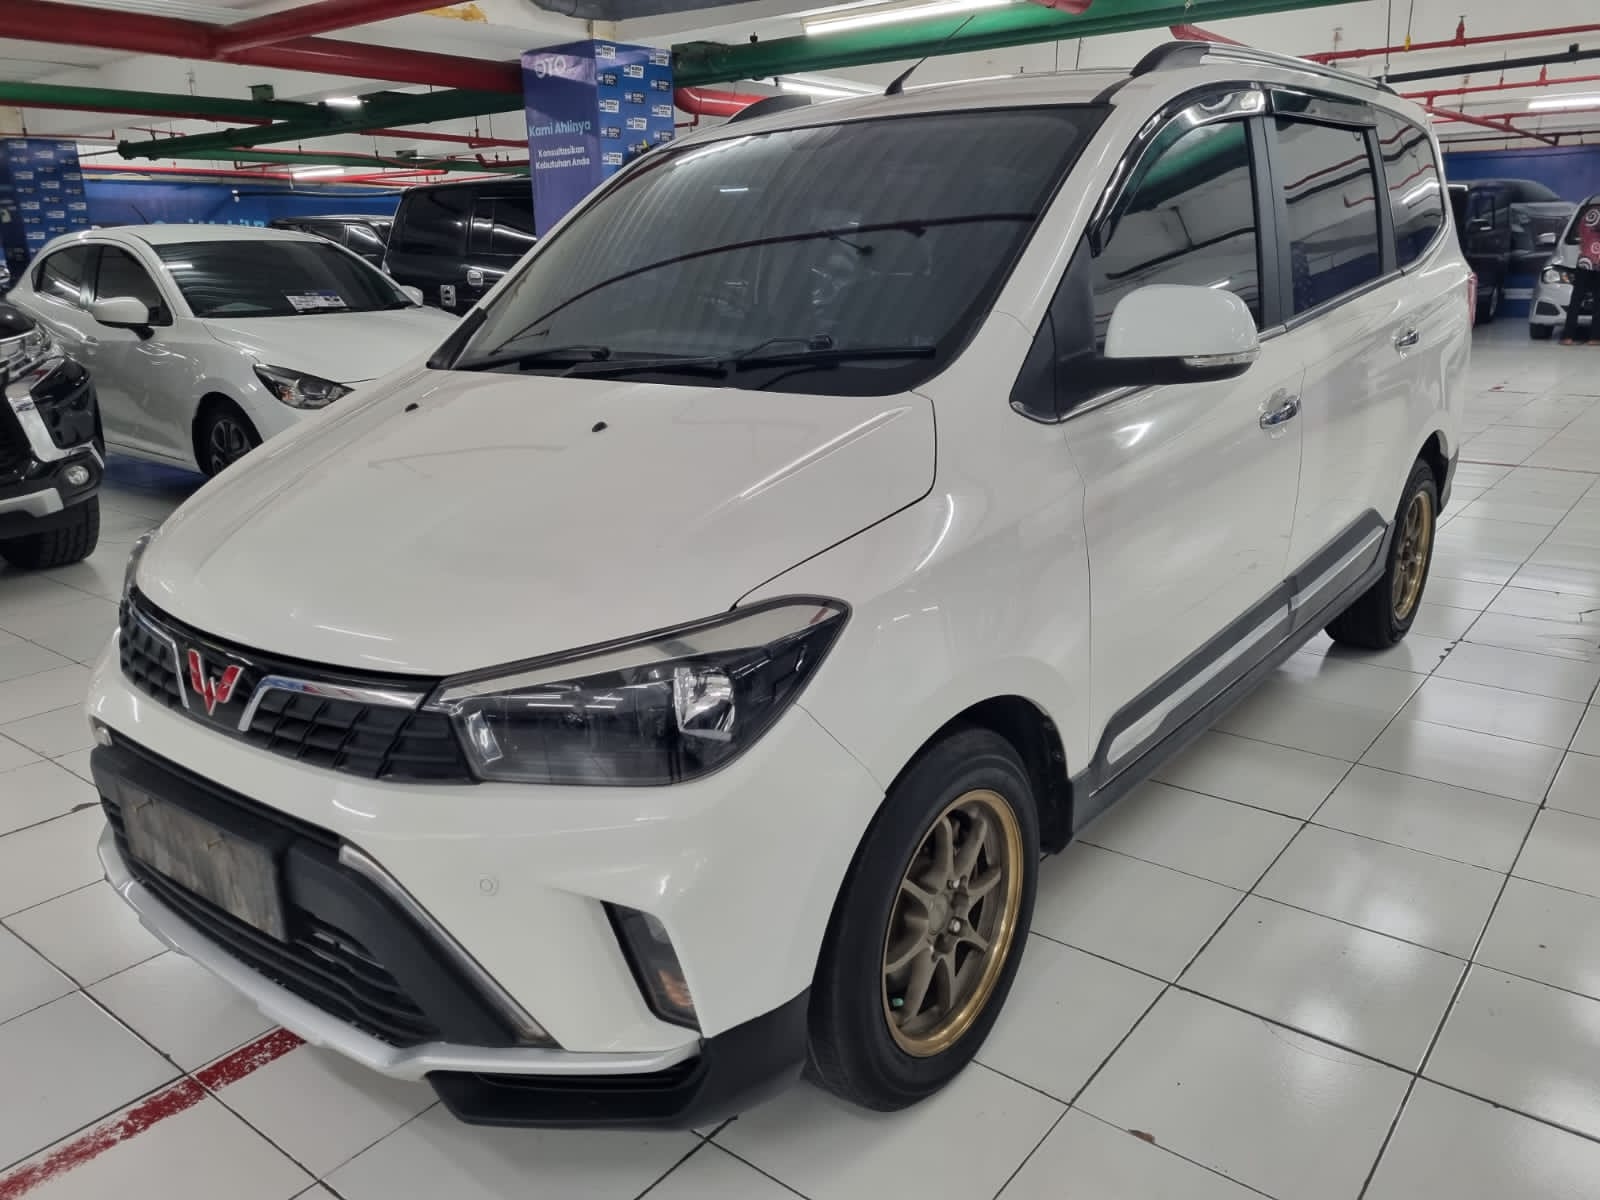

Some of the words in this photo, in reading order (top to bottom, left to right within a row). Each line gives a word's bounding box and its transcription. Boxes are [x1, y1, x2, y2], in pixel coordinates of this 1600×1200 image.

[529, 122, 553, 137] Kami
[555, 120, 591, 136] Ahlinya
[572, 157, 590, 168] Anda
